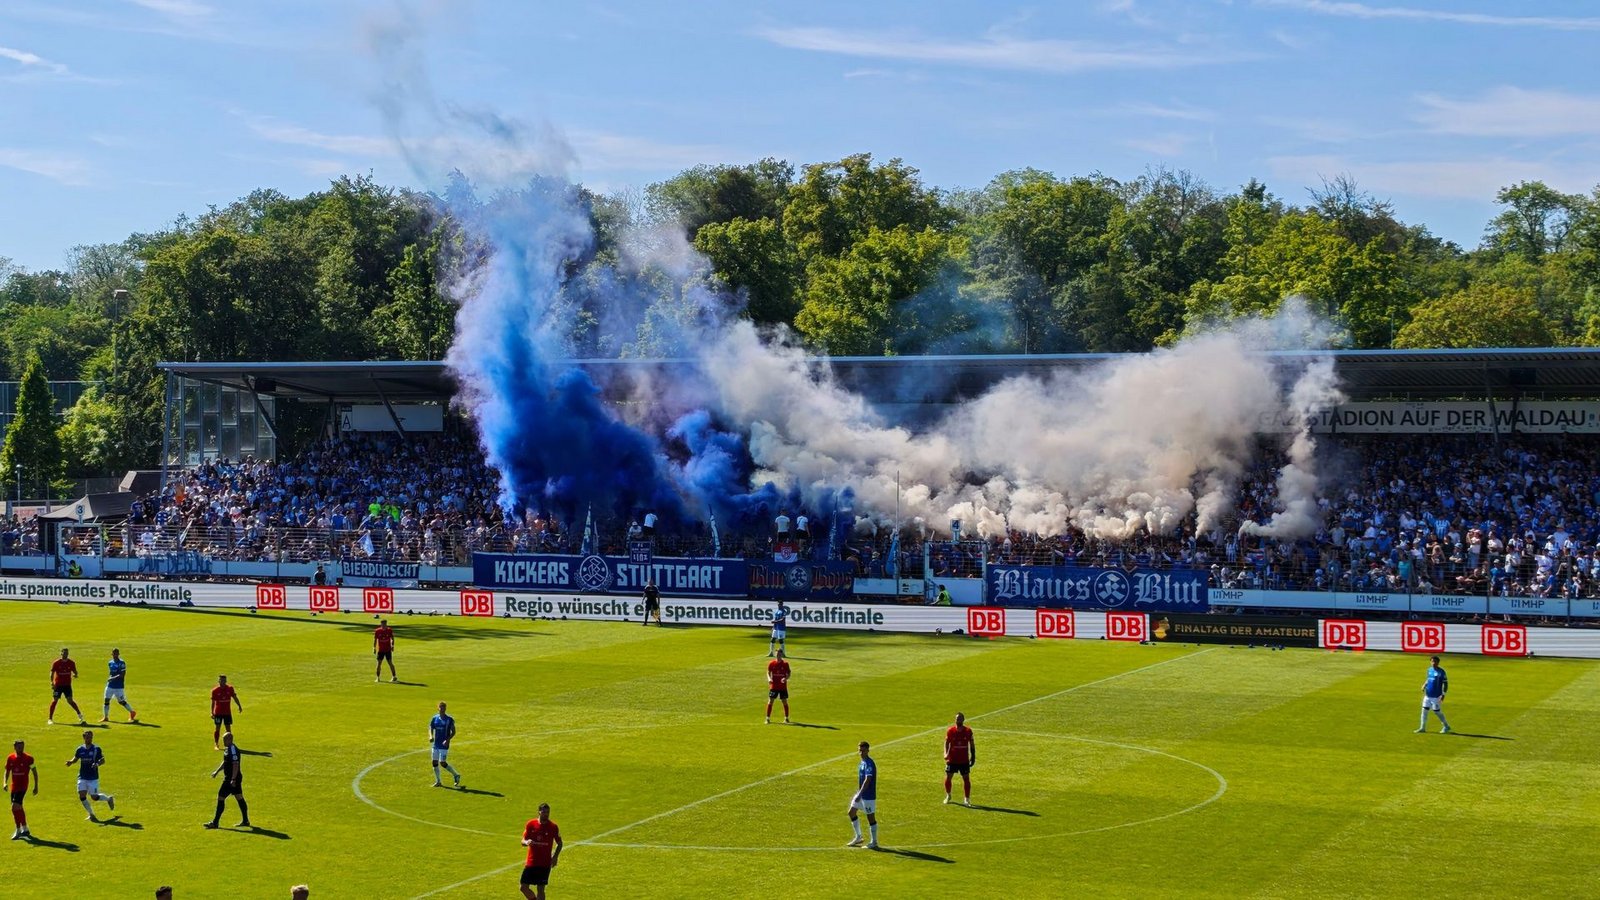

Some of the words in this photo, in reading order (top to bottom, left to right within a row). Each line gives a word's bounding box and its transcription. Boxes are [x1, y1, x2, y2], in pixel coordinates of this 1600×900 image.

[343, 413, 350, 428] A
[1305, 410, 1394, 426] STADION
[1400, 410, 1440, 426] AUF
[1447, 410, 1485, 426] DER
[1497, 410, 1585, 426] WALDAU
[952, 520, 959, 529] 4
[343, 562, 418, 577] BIERDURSCHT
[495, 561, 569, 584] KICKERS
[616, 564, 723, 589] STUTTGART
[20, 583, 105, 598] spannendes
[110, 584, 192, 601] Pokalfinale
[994, 569, 1091, 601] Blaues
[1133, 573, 1201, 606] Blut
[1222, 591, 1244, 600] MHP
[260, 589, 283, 605] DB
[313, 591, 335, 607] DB
[367, 594, 390, 610] DB
[1366, 595, 1388, 604] MHP
[1442, 597, 1464, 607] MHP
[1521, 600, 1545, 609] MHP
[465, 596, 490, 615] DB
[505, 596, 553, 616] Regio
[557, 598, 630, 617] wünscht
[665, 604, 773, 622] spannendes
[783, 606, 883, 625] Pokalfinale
[973, 611, 1000, 632] DB
[1041, 614, 1069, 635] DB
[1112, 616, 1141, 637] DB
[1175, 624, 1227, 635] FINALTAG
[1230, 626, 1252, 636] DER
[1256, 627, 1316, 638] AMATEURE
[1329, 624, 1361, 645] DB
[1407, 627, 1440, 648] DB
[1487, 630, 1521, 651] DB
